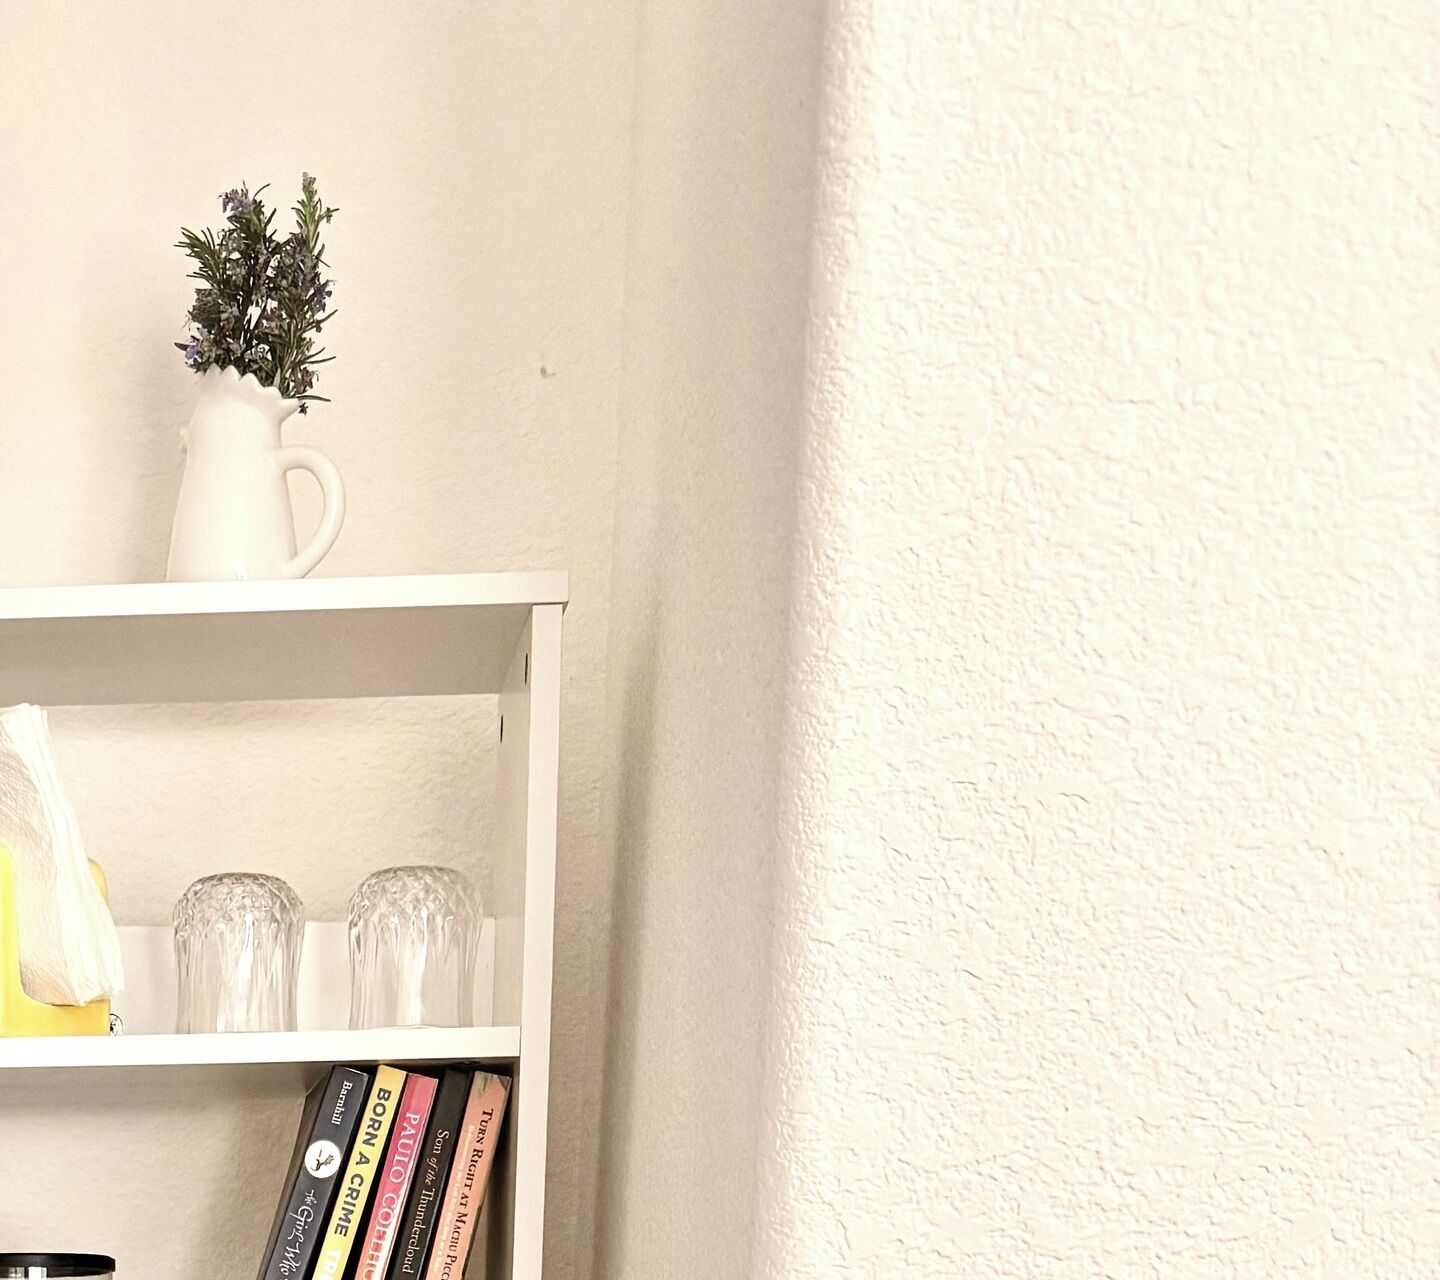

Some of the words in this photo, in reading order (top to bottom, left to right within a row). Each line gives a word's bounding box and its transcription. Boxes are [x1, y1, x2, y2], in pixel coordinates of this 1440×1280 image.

[332, 1081, 353, 1125] Barnhill
[362, 1088, 392, 1147] BORN
[356, 1152, 371, 1166] A
[390, 1112, 421, 1183] PAULO
[427, 1157, 439, 1170] of
[434, 1130, 450, 1154] Son
[425, 1170, 437, 1186] the
[334, 1174, 364, 1237] CRIME
[402, 1188, 436, 1274] Thundercloud
